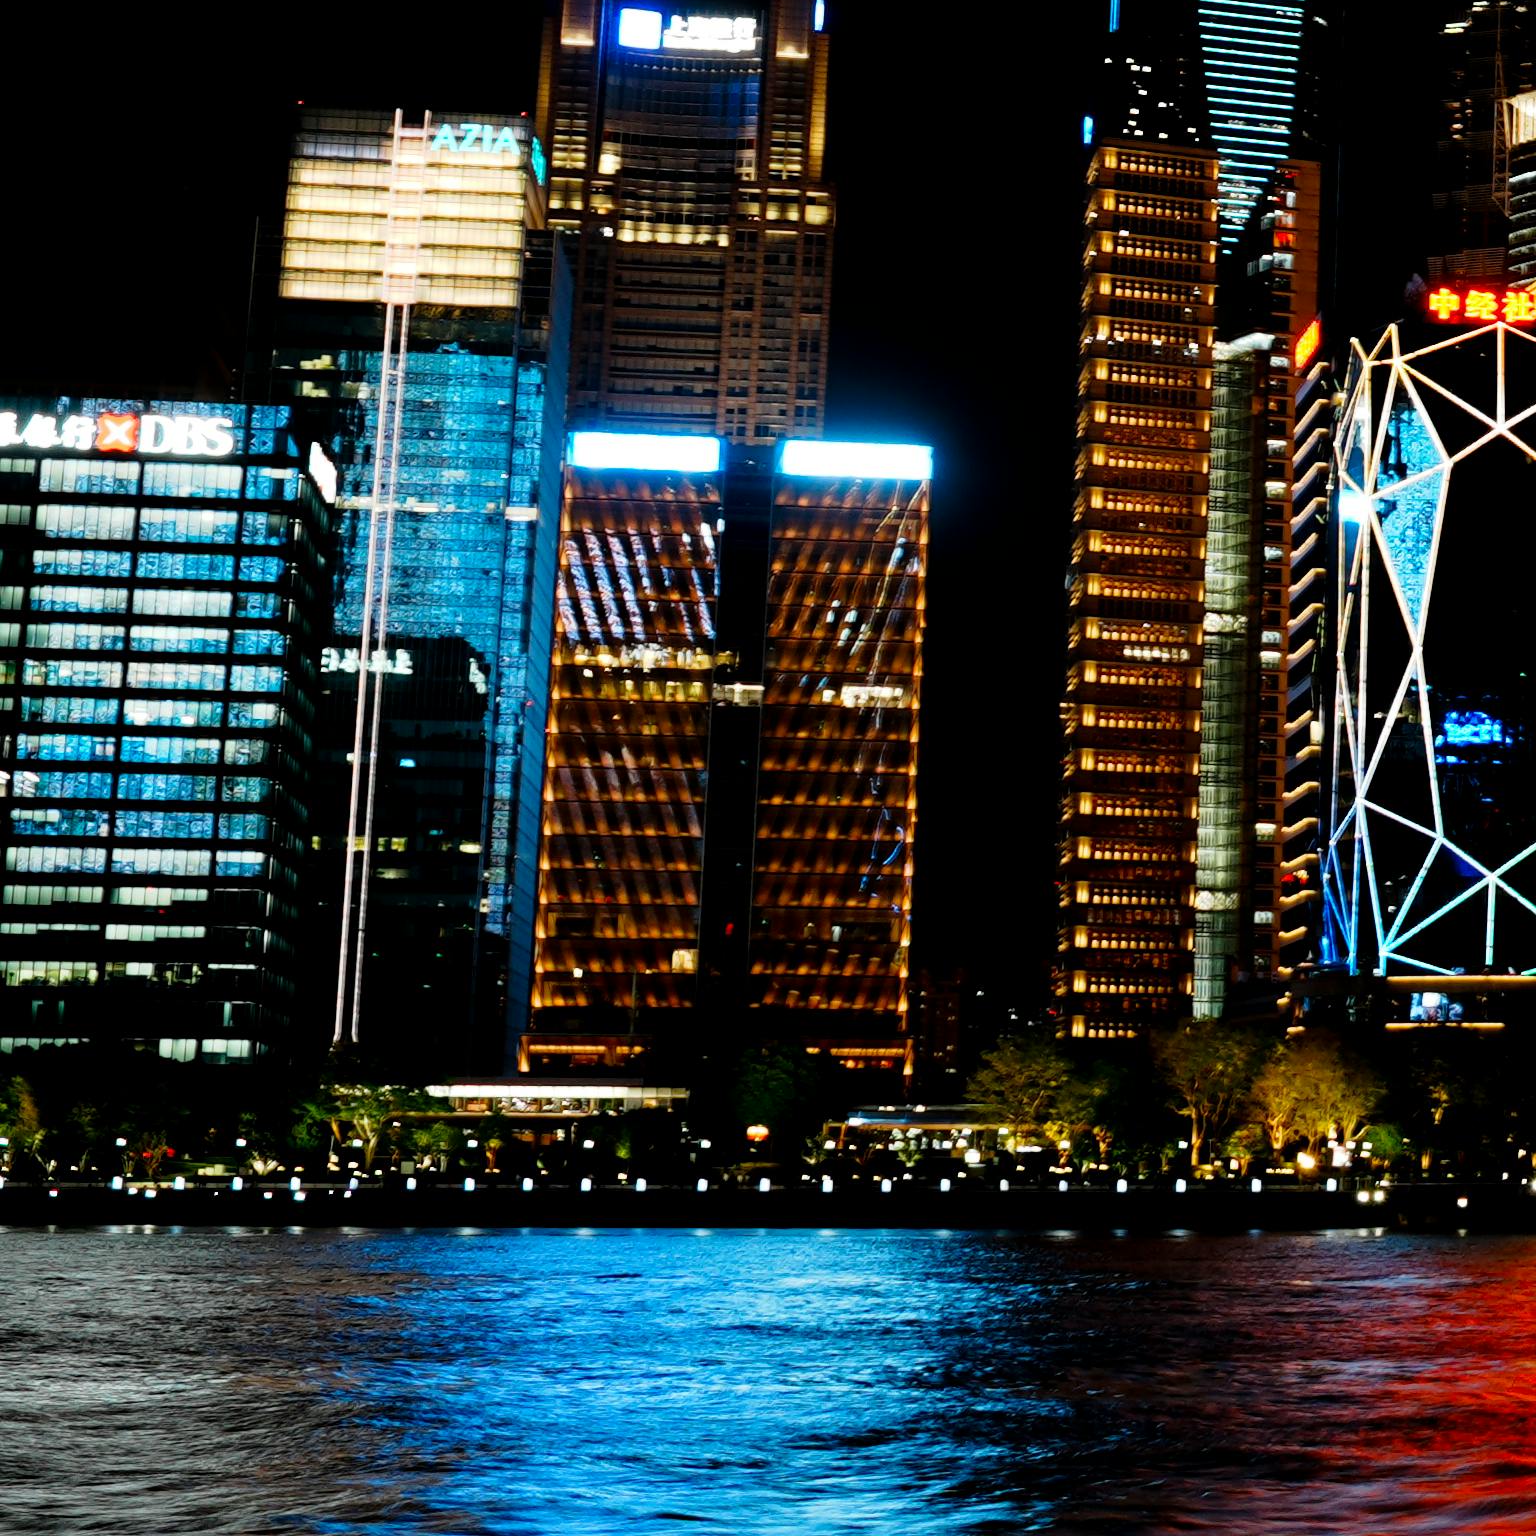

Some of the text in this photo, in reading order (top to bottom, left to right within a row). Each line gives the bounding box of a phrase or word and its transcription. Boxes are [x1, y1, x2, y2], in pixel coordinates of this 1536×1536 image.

[430, 124, 521, 156] AZIA
[1429, 288, 1535, 322] 中经社
[140, 415, 234, 456] DBS
